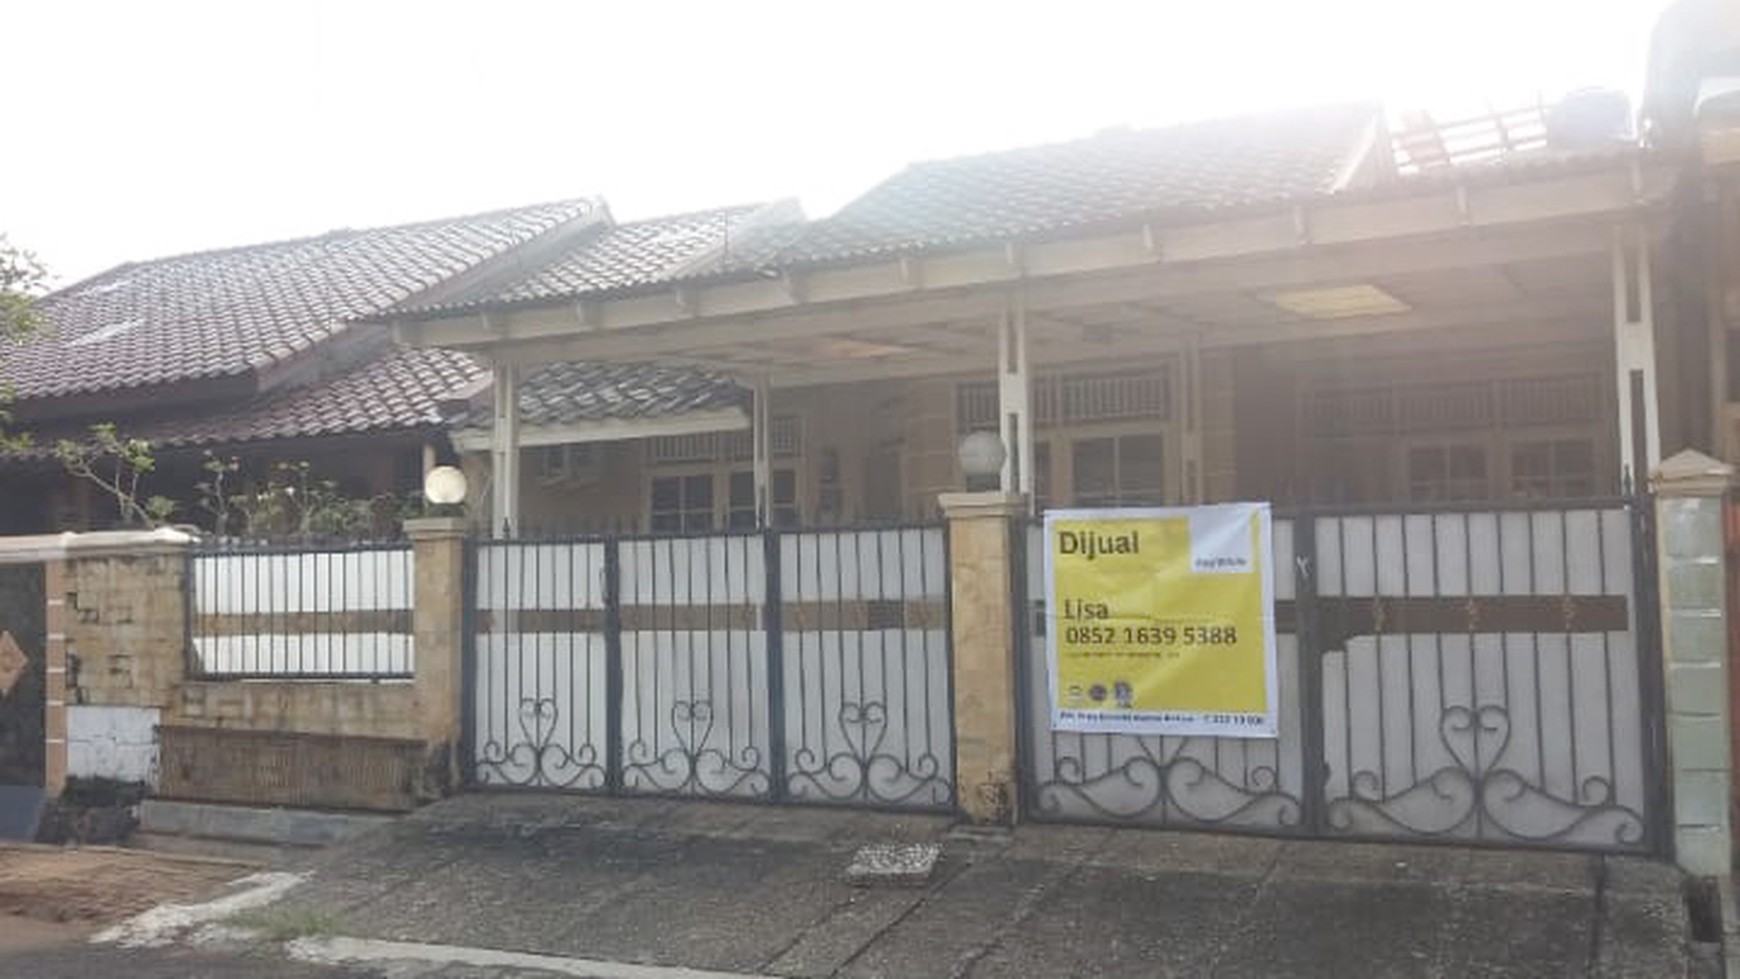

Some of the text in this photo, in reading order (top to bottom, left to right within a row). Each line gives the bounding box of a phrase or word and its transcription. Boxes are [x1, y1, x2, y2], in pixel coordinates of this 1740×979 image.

[1059, 531, 1139, 561] Dijual
[1064, 599, 1109, 621] Lisa
[1066, 627, 1238, 646] 0852 1639 5388
